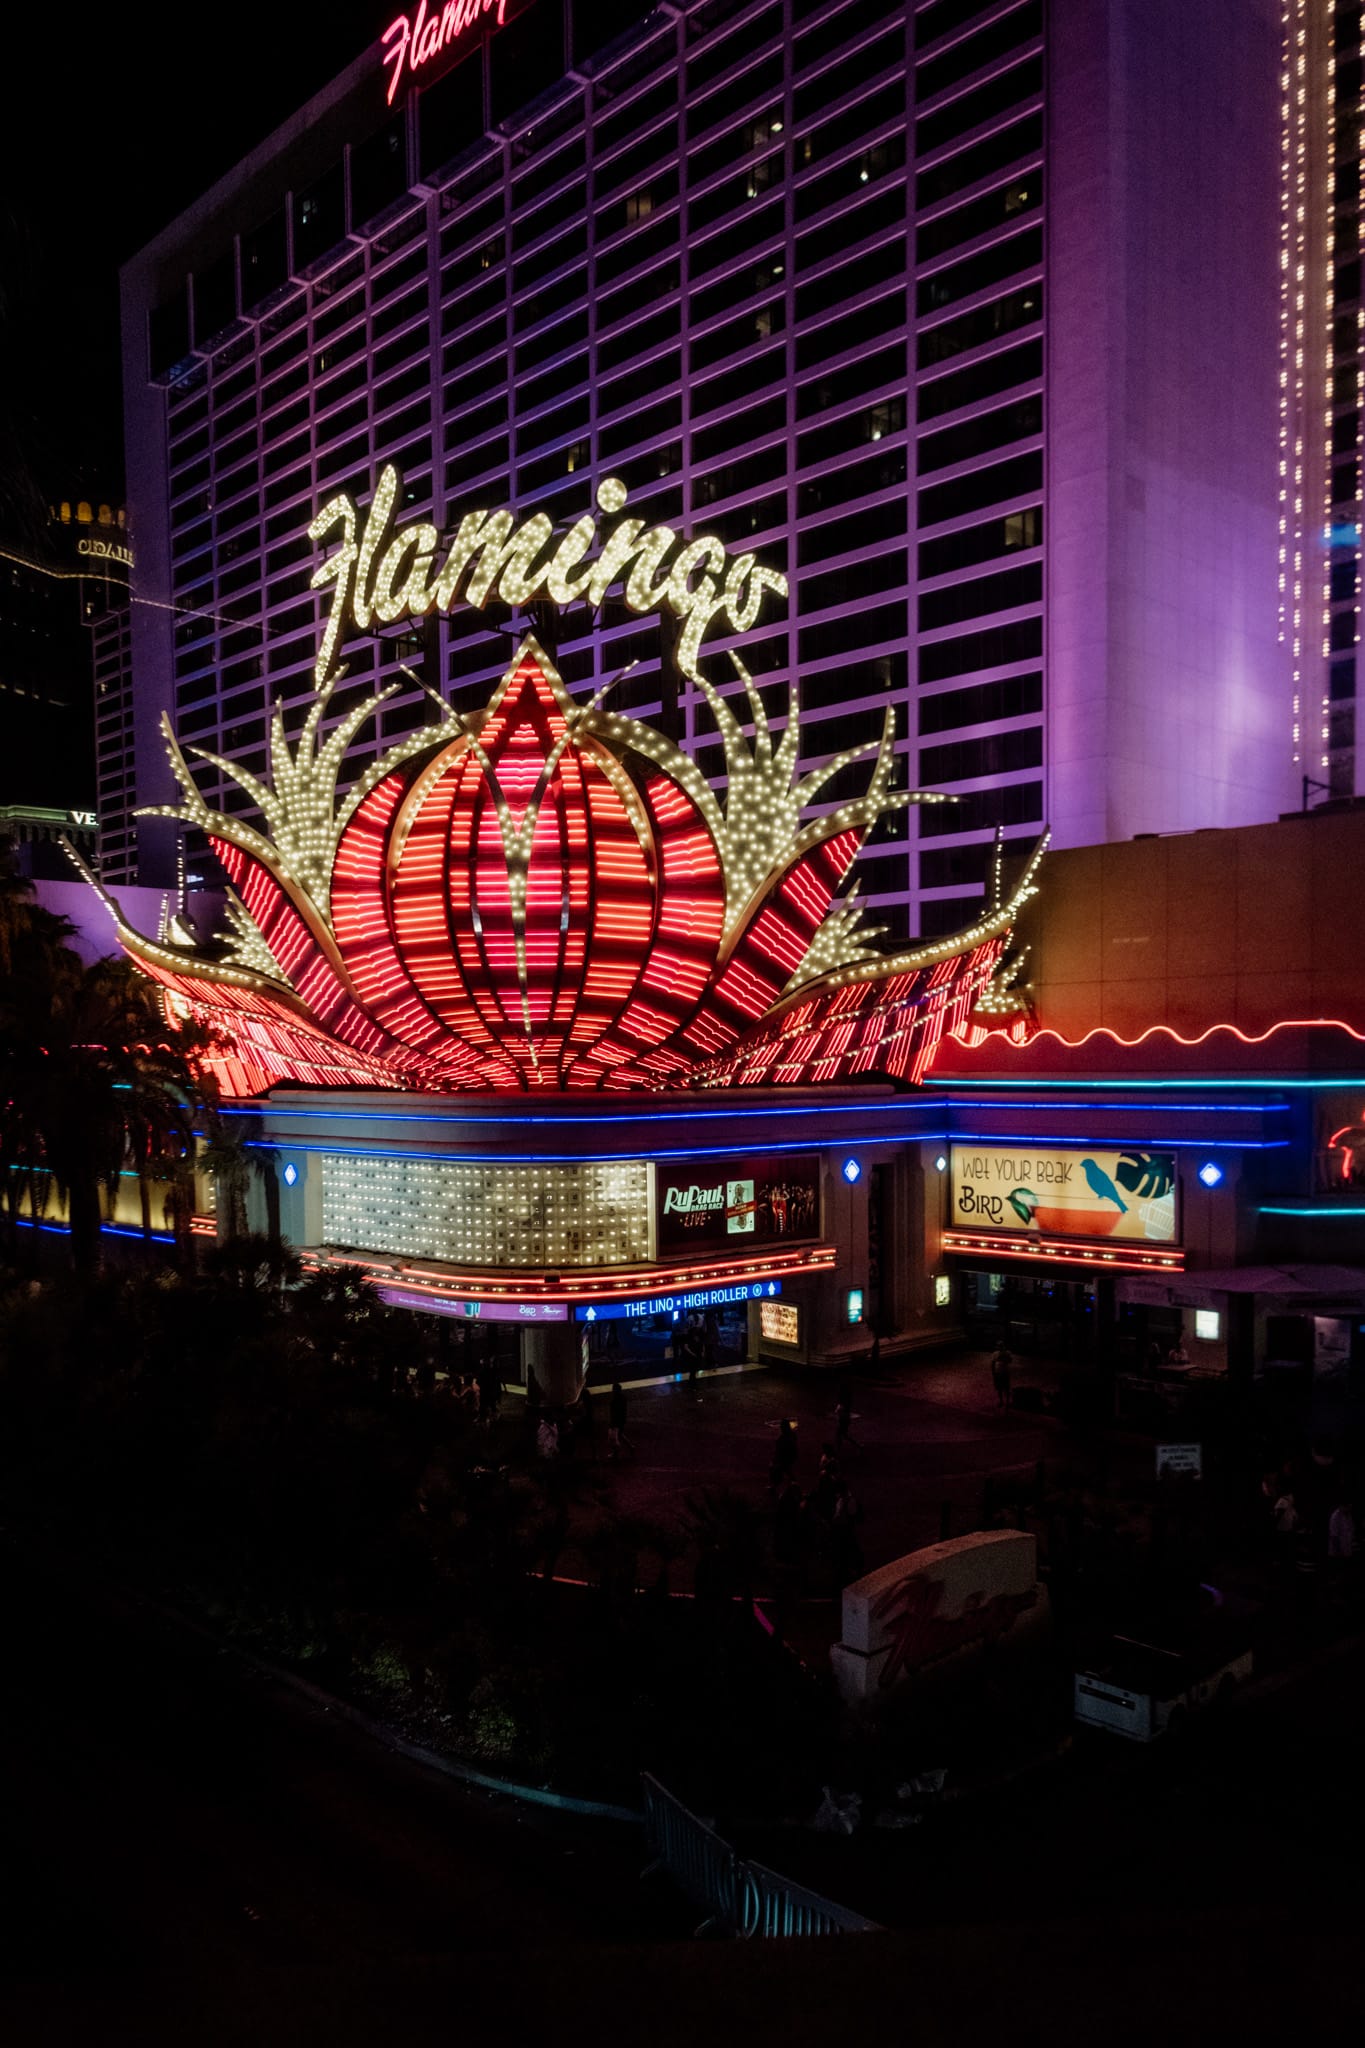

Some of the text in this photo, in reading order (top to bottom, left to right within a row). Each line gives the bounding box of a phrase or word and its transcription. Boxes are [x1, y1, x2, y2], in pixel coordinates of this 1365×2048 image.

[308, 463, 789, 692] Flamingo
[70, 810, 99, 826] VE
[995, 1158, 1032, 1182] YOUR
[684, 1212, 708, 1228] LIVE
[624, 1287, 748, 1317] THE LINQ HIGH ROLLER
